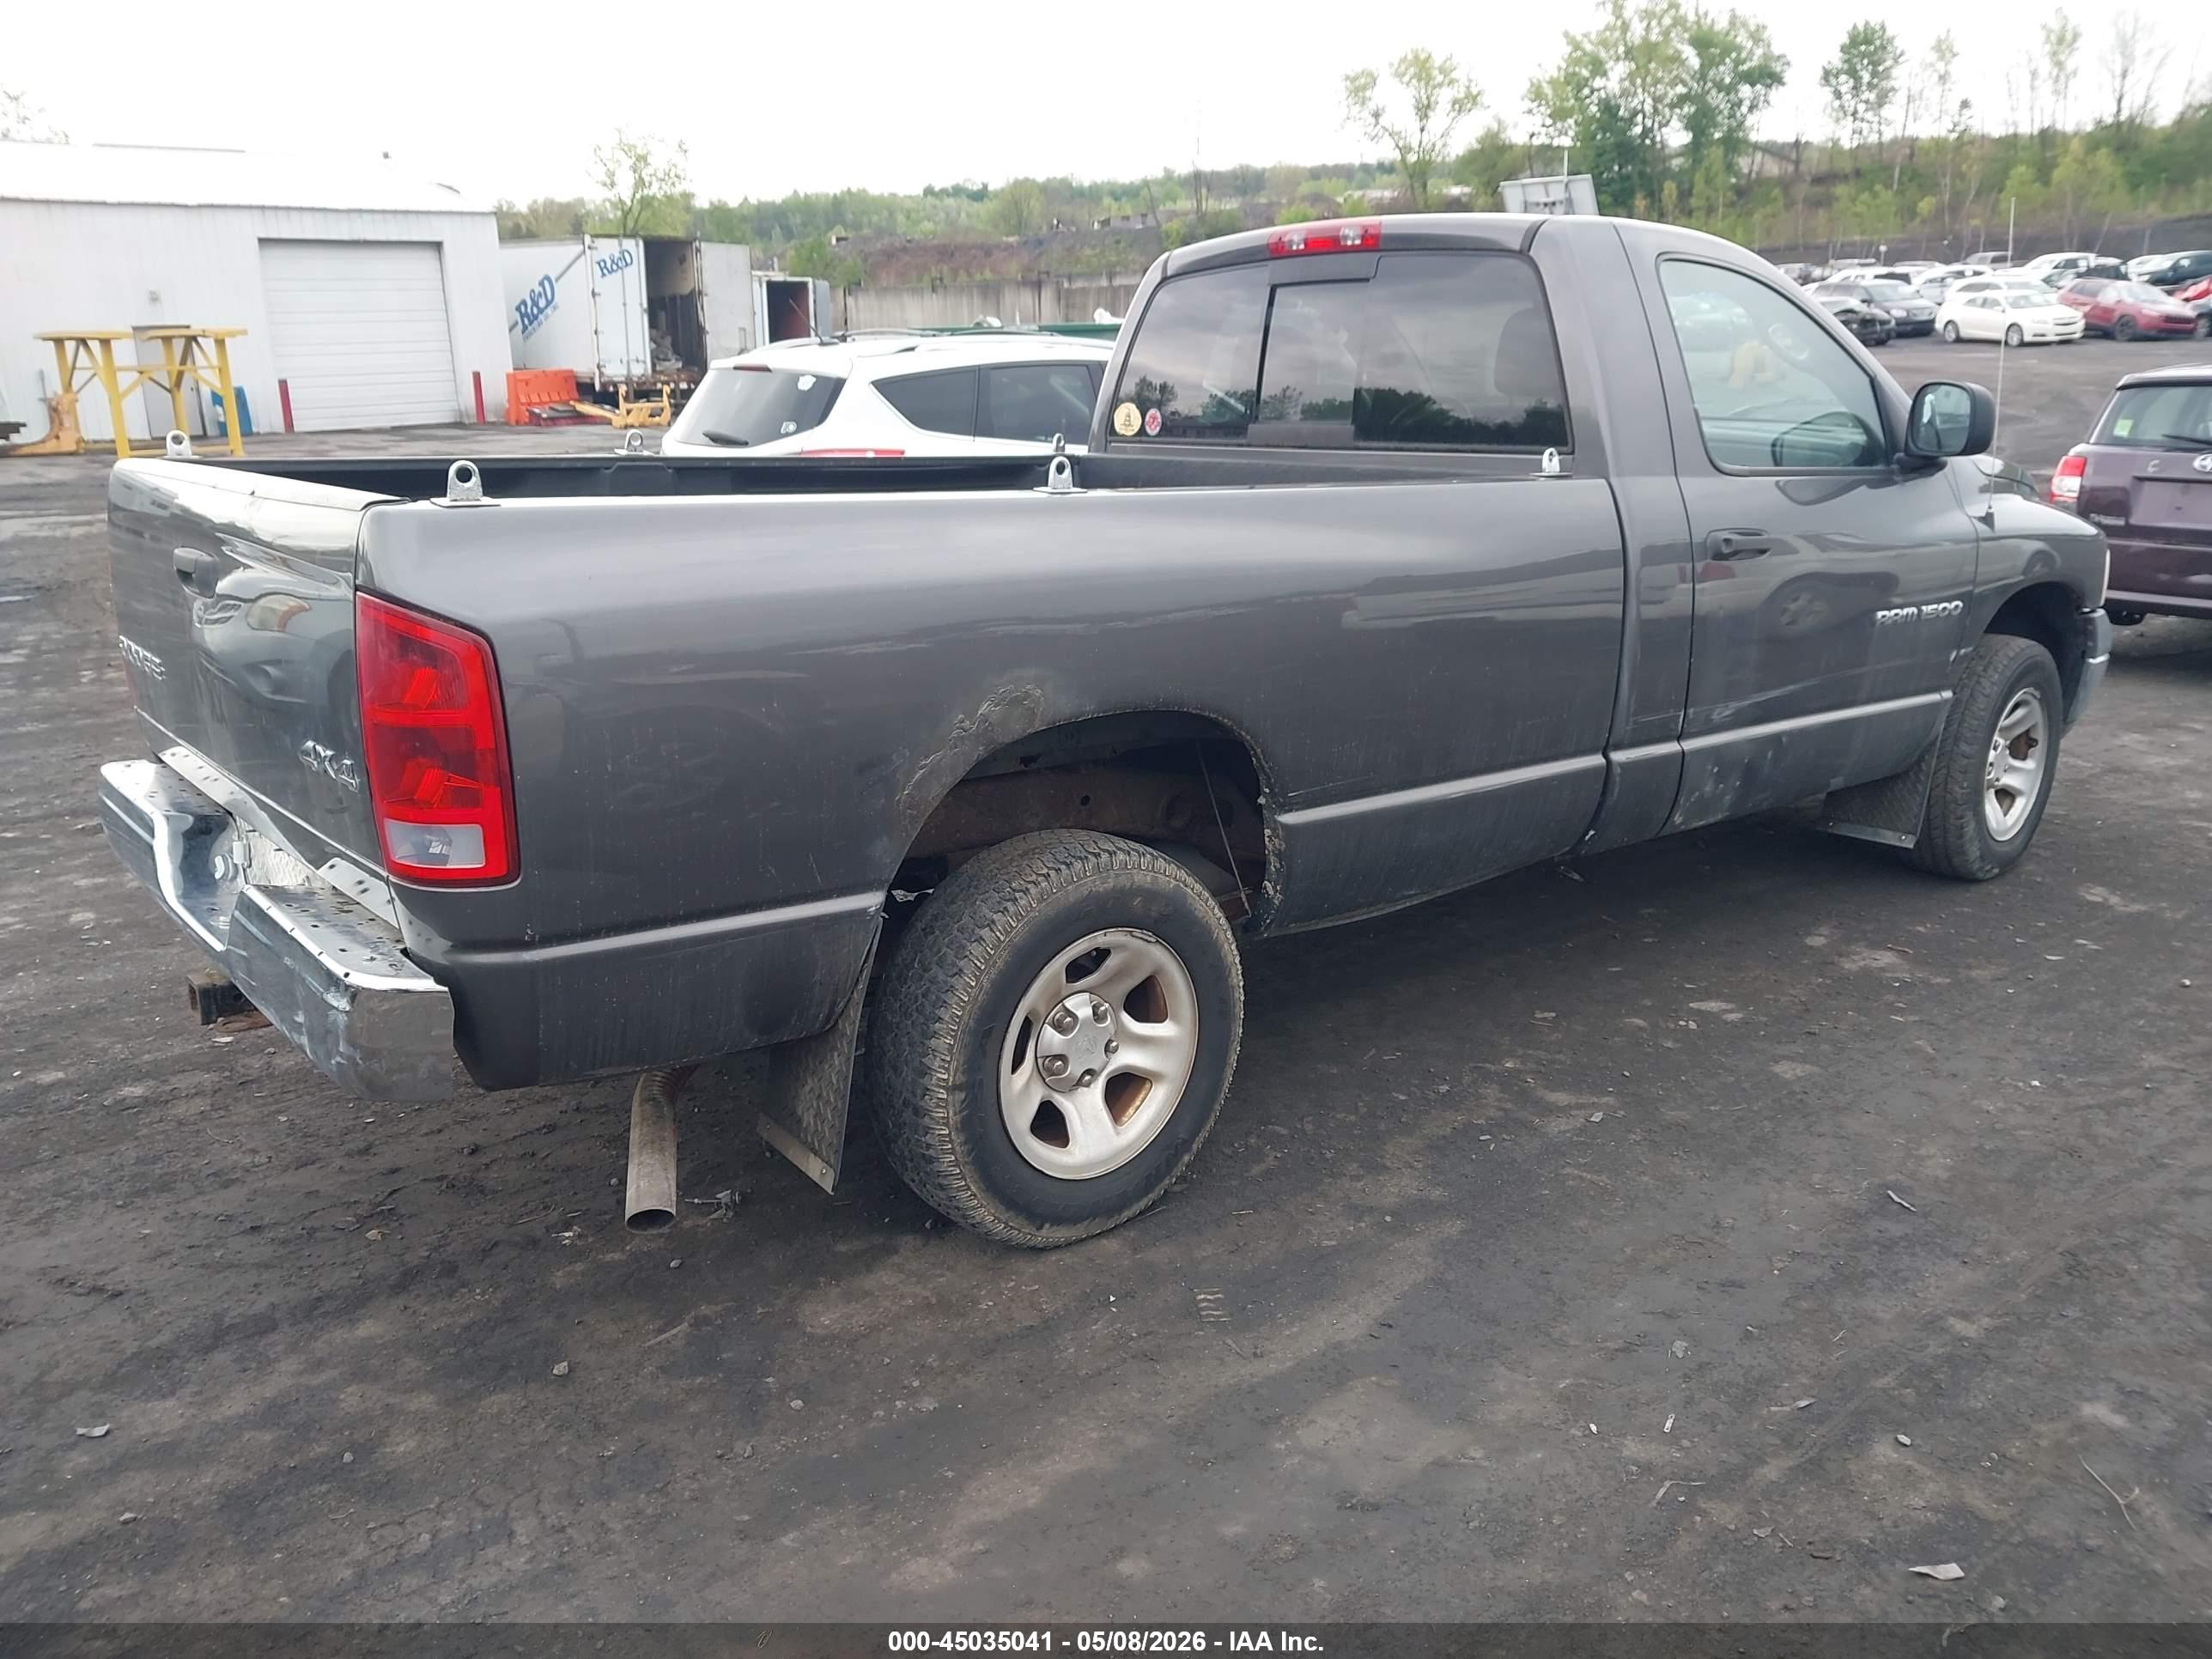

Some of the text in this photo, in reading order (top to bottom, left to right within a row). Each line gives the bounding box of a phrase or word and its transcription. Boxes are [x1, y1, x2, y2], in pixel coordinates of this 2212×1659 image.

[596, 249, 634, 278] R&D
[515, 274, 556, 335] R&D
[1921, 600, 1964, 620] 1500
